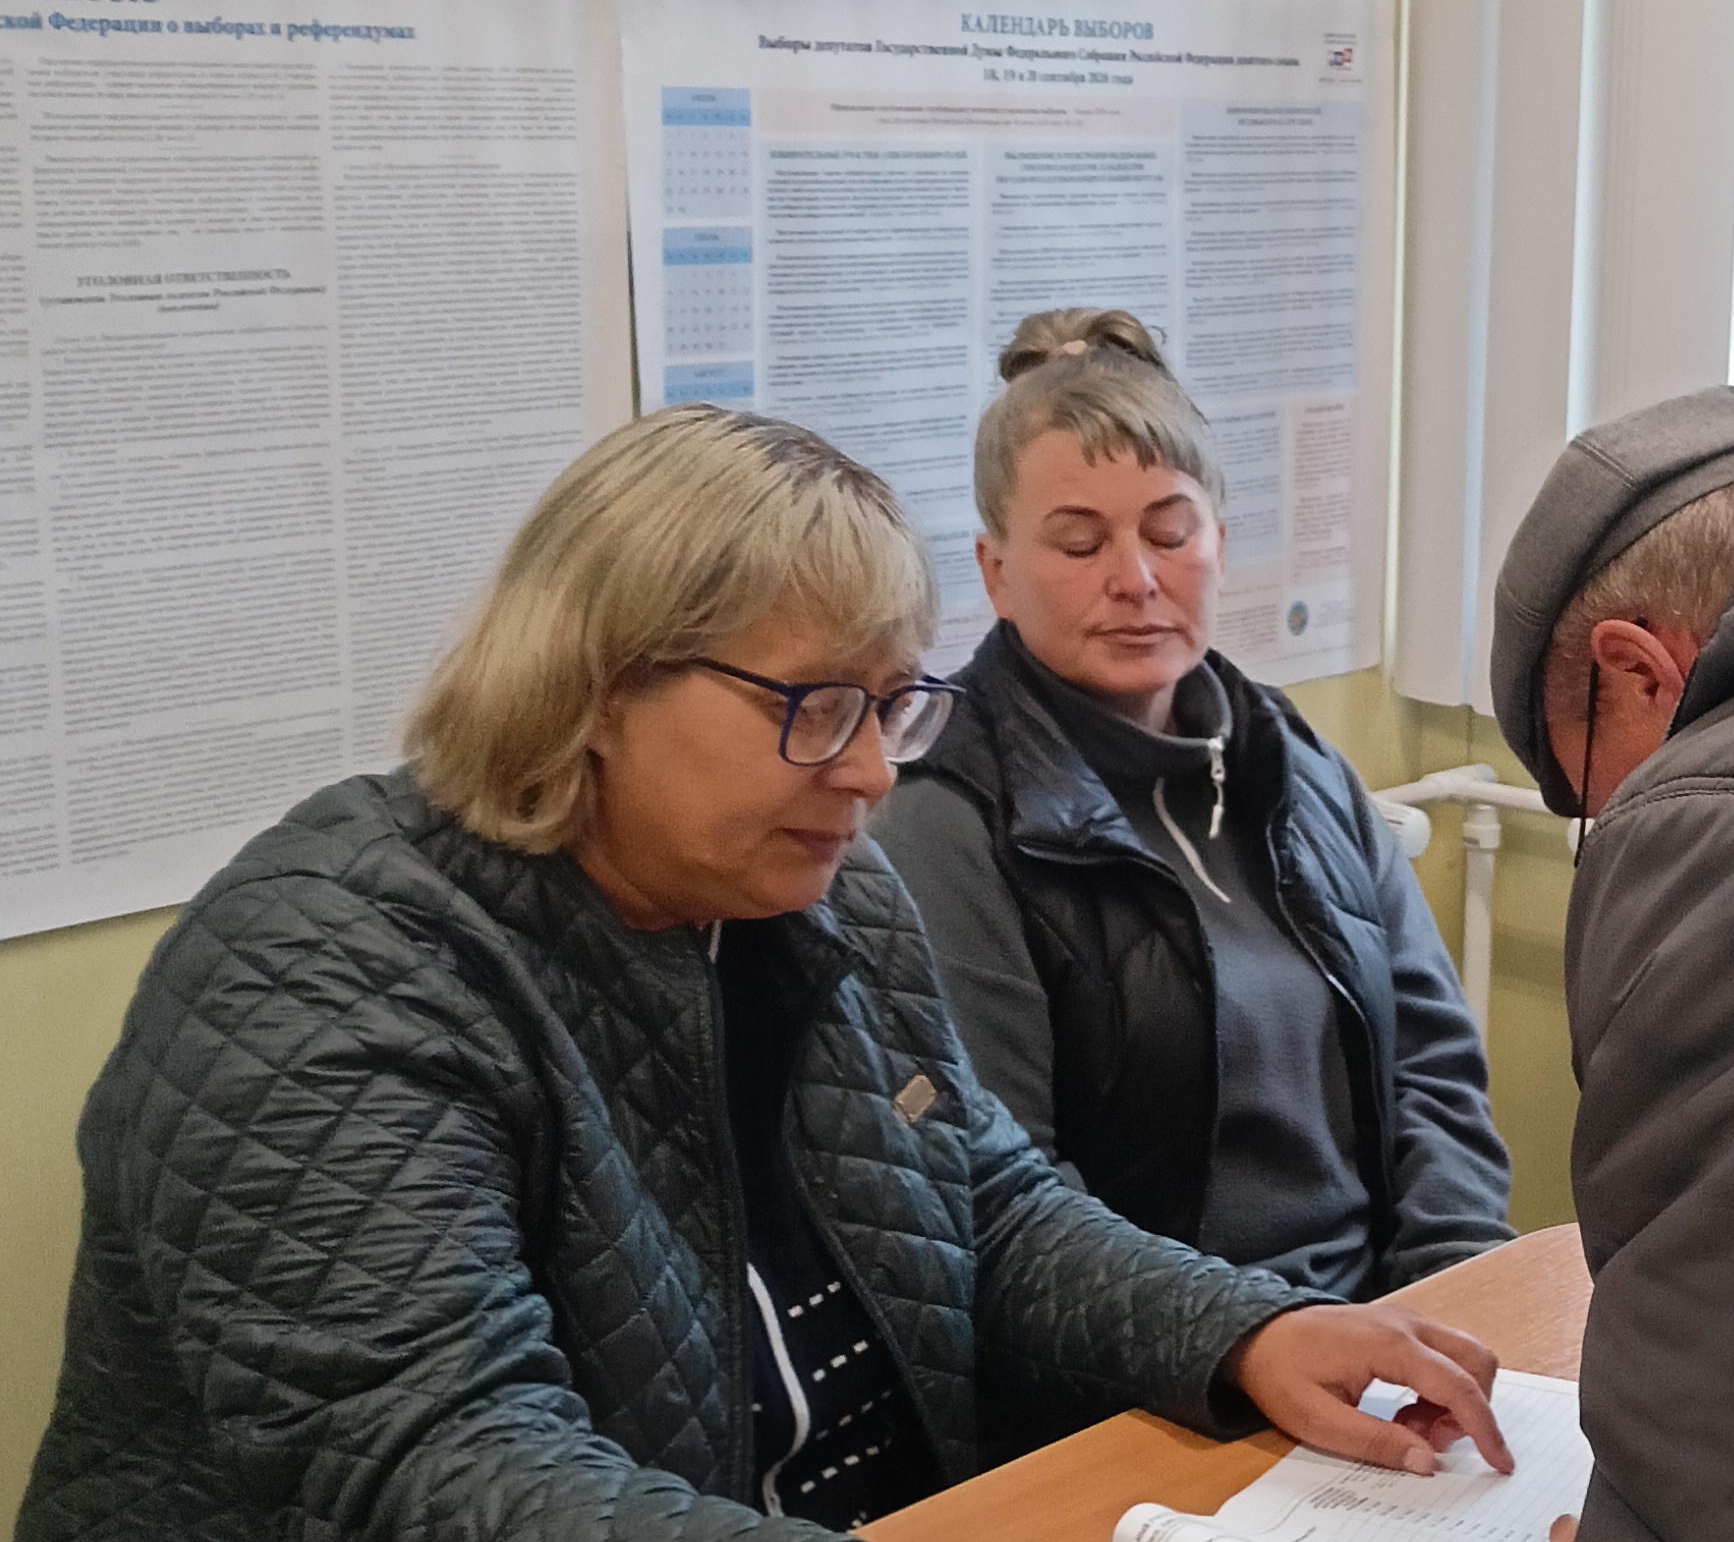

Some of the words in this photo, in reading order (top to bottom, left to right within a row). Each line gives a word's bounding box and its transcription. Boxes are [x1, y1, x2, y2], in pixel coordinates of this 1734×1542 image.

[48, 12, 162, 36] Федерации
[167, 21, 178, 33] о
[184, 16, 267, 40] выборах
[270, 24, 281, 35] и
[287, 19, 416, 43] референдумах
[961, 13, 1070, 38] КАЛЕНДАРЬ
[1074, 18, 1155, 40] ВЫБОРОВ
